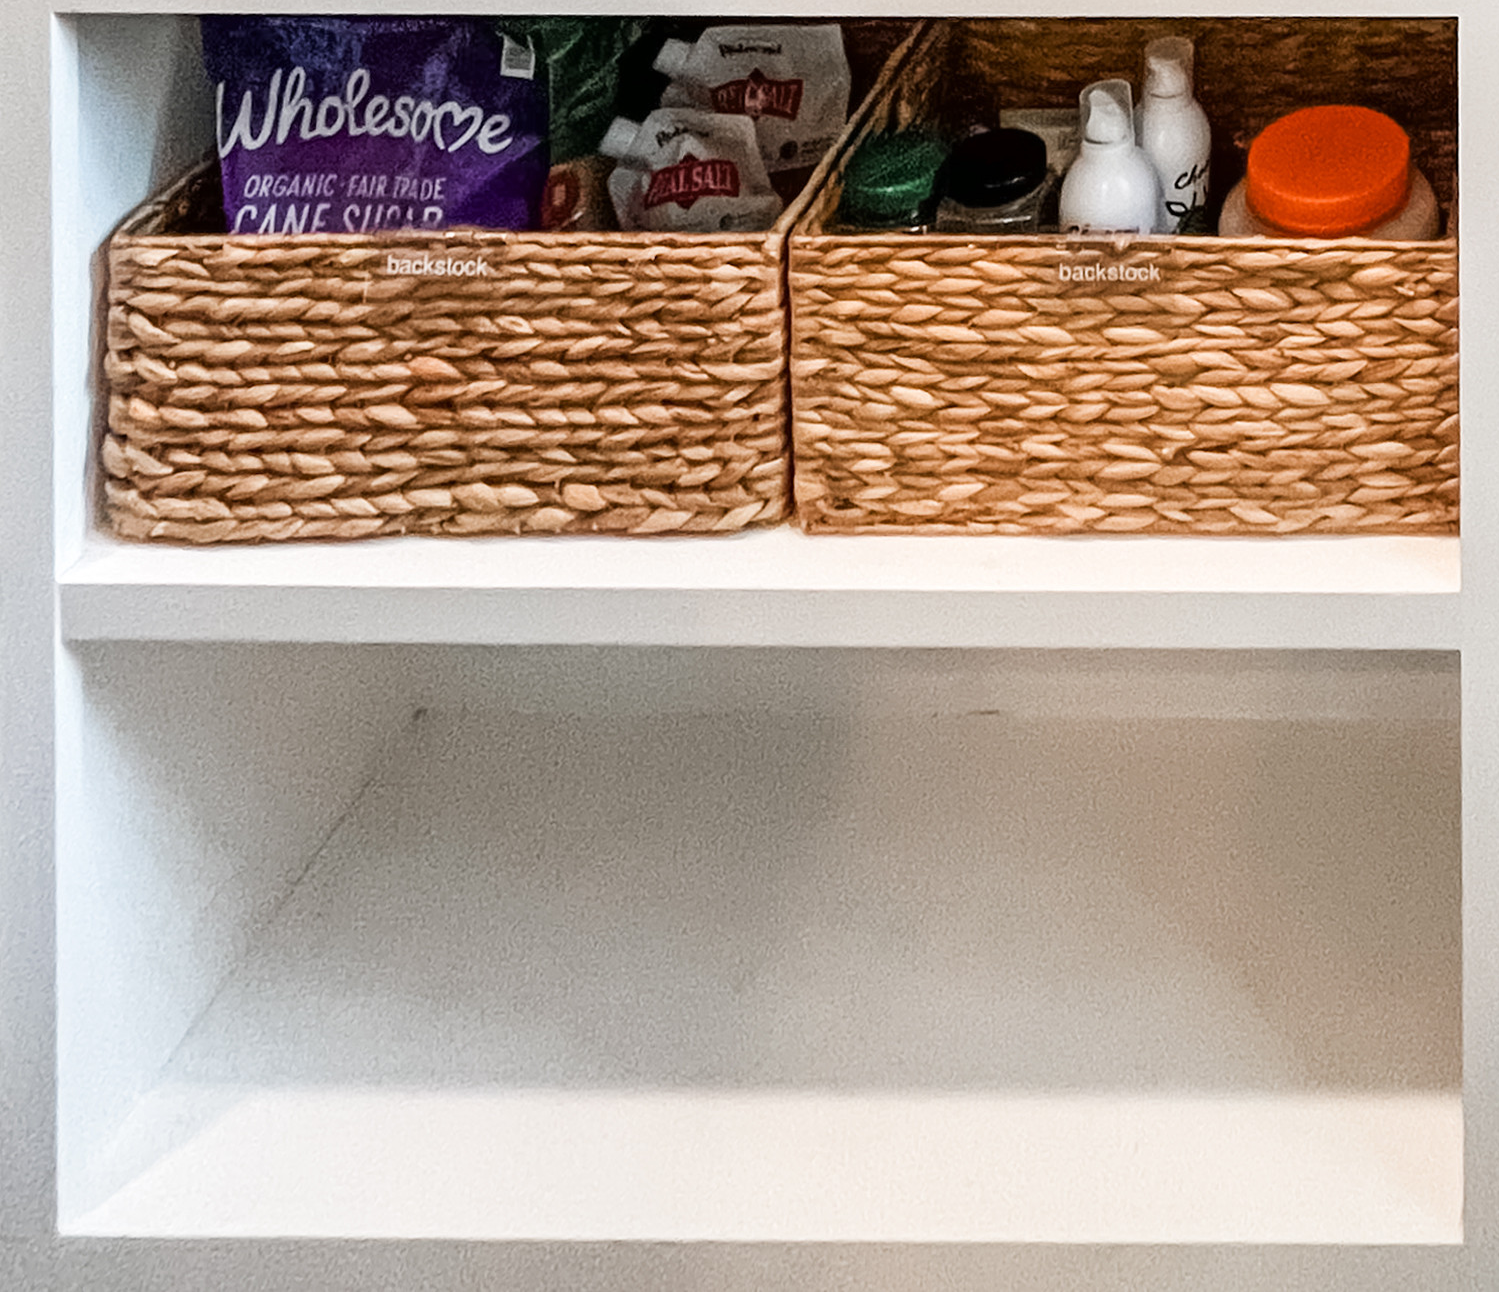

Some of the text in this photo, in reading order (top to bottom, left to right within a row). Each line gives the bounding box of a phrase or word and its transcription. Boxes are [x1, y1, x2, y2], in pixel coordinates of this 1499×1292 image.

[243, 173, 447, 202] ORGANIC FAIR TRADE
[691, 167, 733, 192] SALT
[231, 203, 332, 234] CANE
[386, 255, 488, 277] backstock
[1058, 263, 1161, 282] backstock
